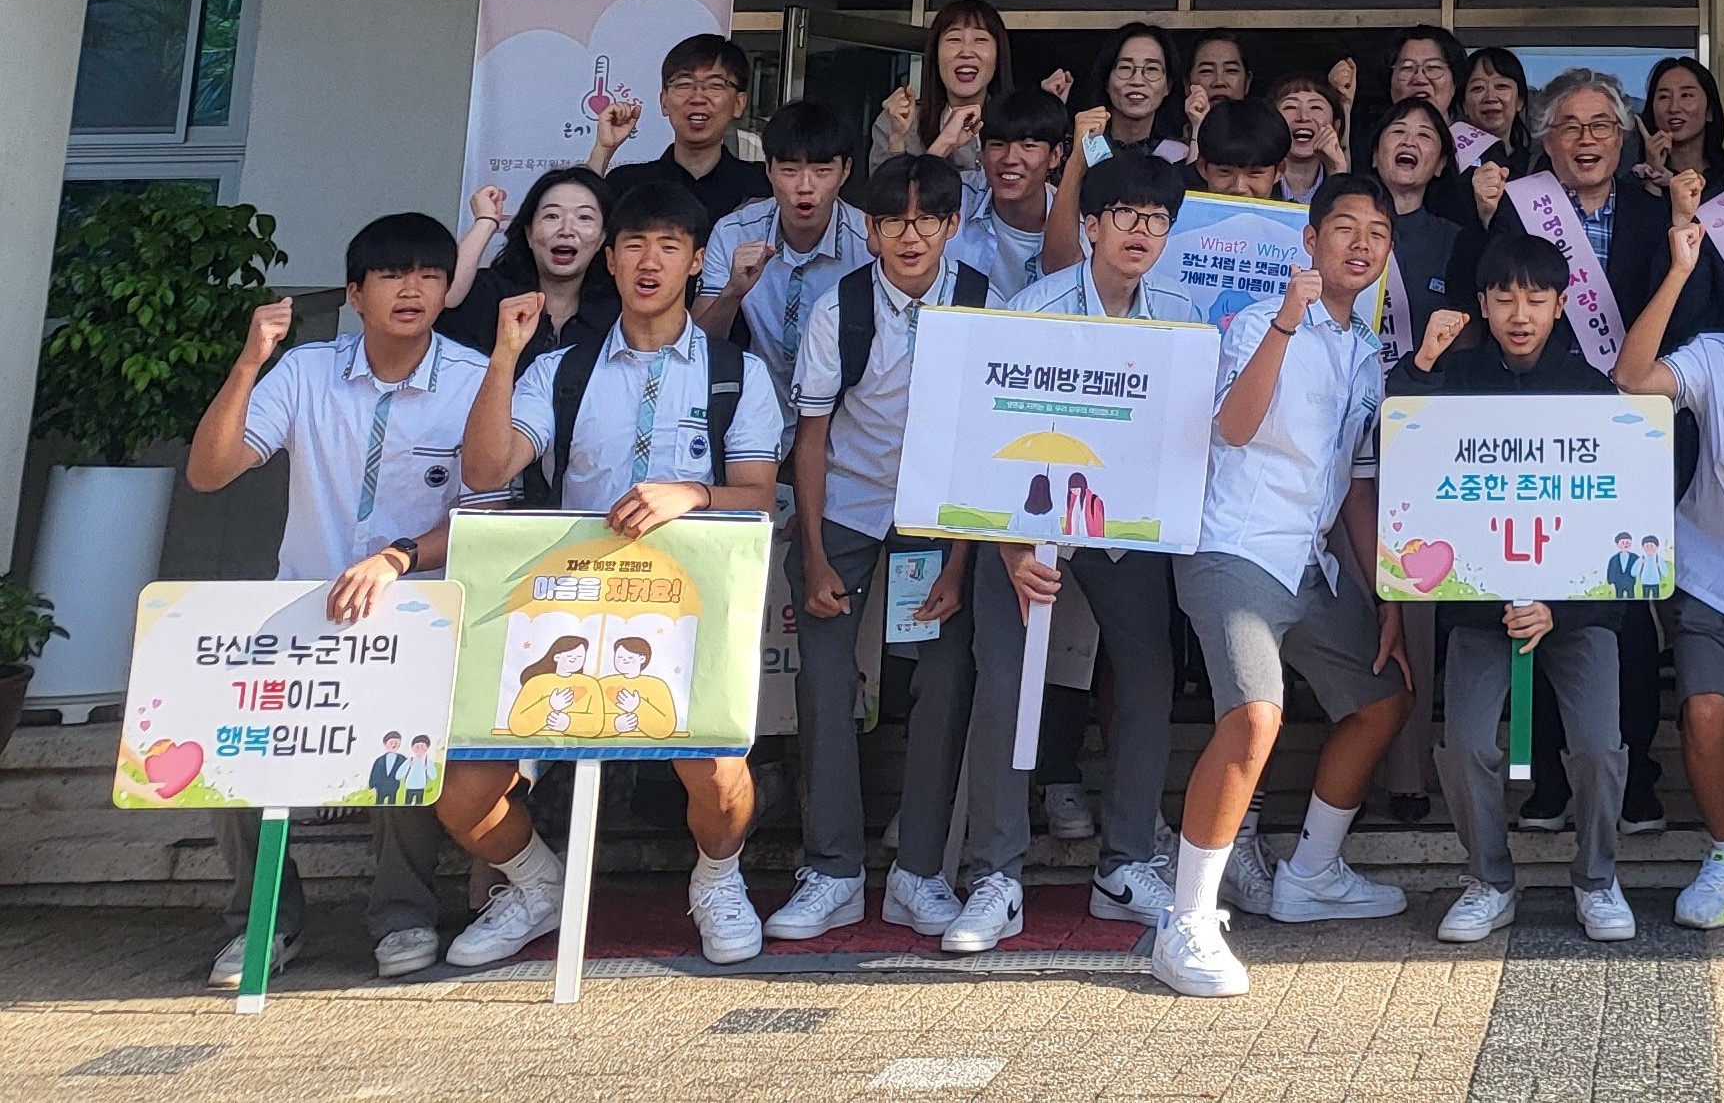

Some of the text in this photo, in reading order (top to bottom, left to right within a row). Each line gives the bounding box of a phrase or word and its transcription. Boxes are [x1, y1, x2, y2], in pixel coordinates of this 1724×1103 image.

[1200, 236, 1298, 262] What? Why?
[1182, 252, 1292, 278] 장난 처럼 쓴 댓글이
[1180, 270, 1219, 287] 가에겐
[1221, 275, 1235, 289] 큰
[1238, 277, 1275, 293] 아픔이
[985, 361, 1149, 400] 자살 예방 캠페인
[1454, 437, 1600, 464] 세상에서 가장
[1435, 474, 1618, 502] 소중한 존재 바로
[566, 559, 653, 573] 자살 예방 캠페인
[196, 633, 399, 666] 당신은 누군가의
[231, 679, 350, 712] 기쁨이고,
[216, 724, 358, 757] 행복입니다
